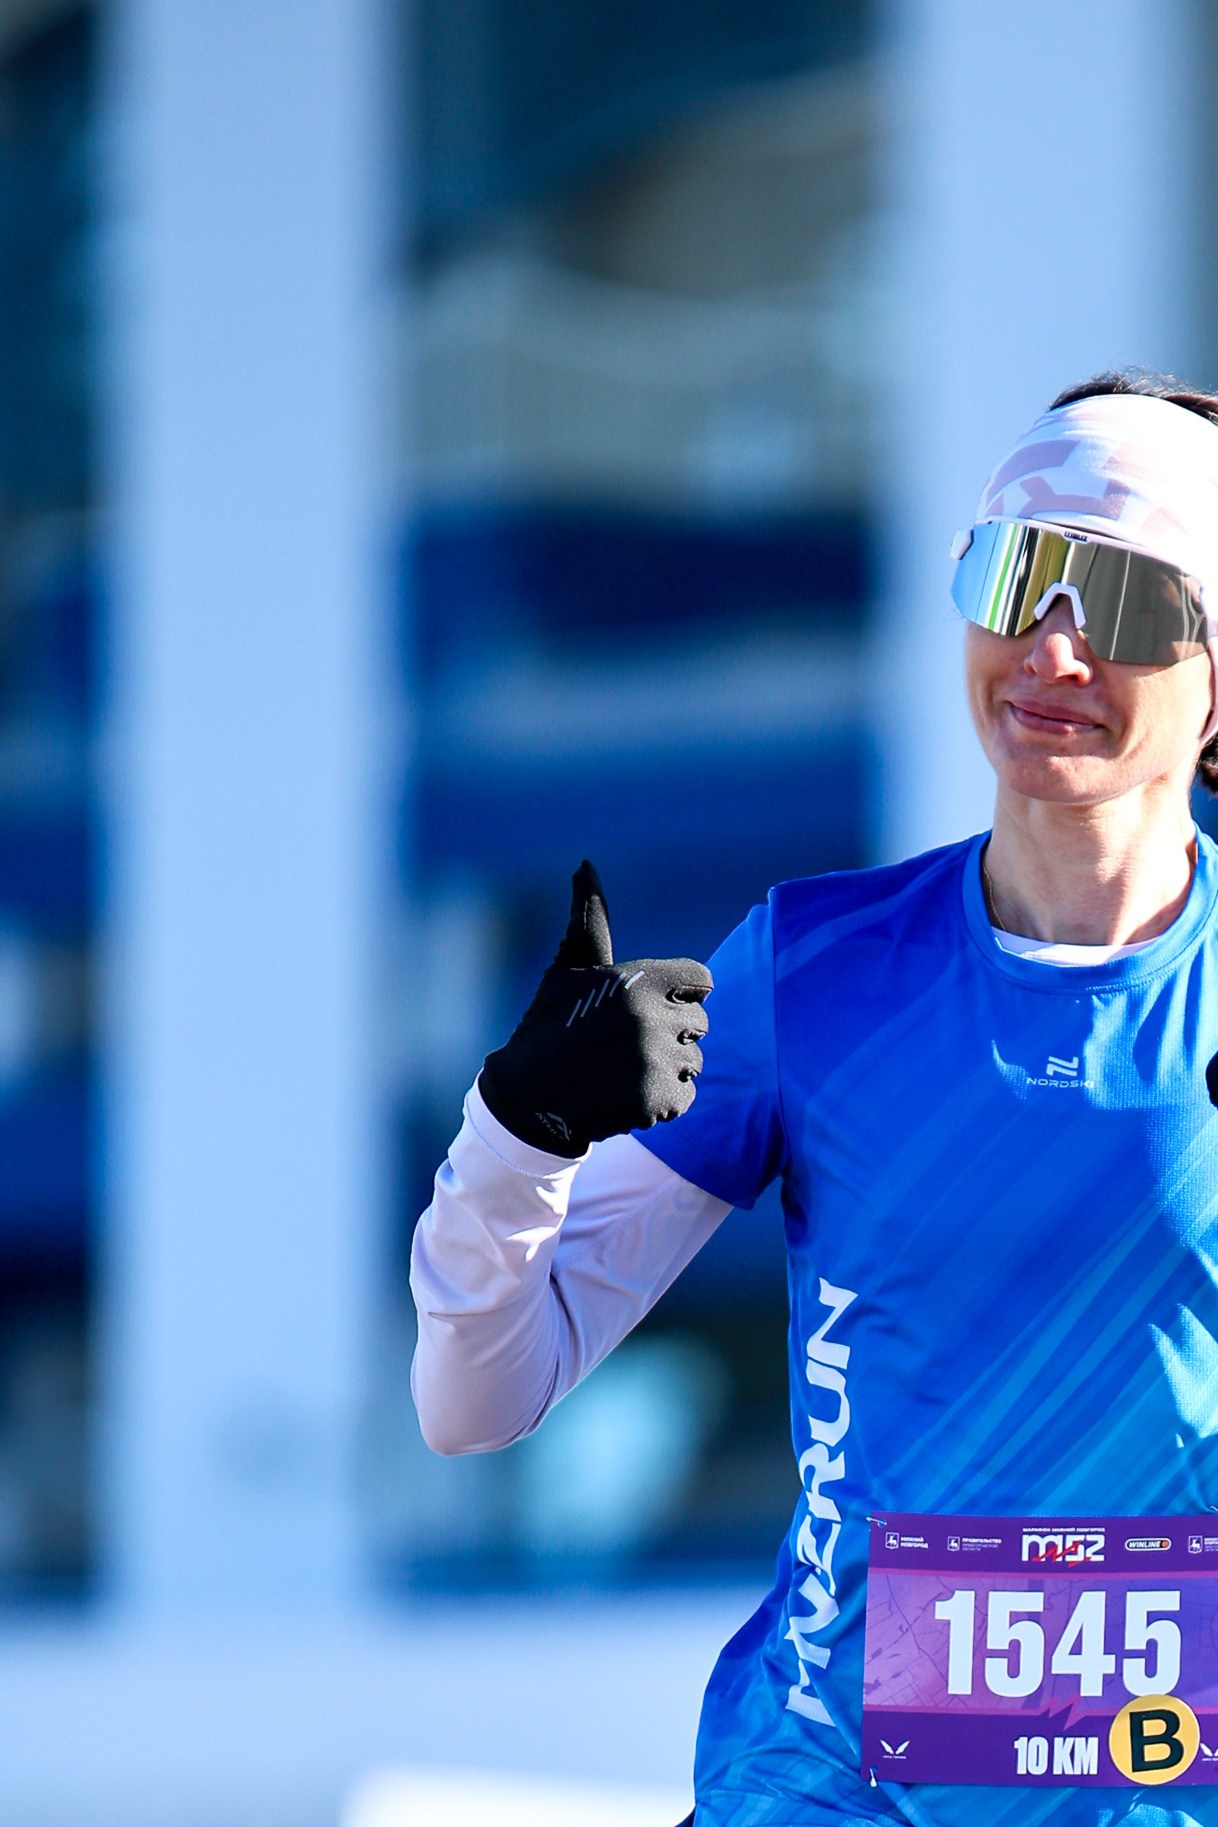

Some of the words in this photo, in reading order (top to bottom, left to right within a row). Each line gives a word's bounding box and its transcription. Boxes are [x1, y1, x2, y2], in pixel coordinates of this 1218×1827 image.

[1026, 1077, 1095, 1089] NORDSKI
[1129, 1540, 1161, 1549] WINLINE
[934, 1590, 1181, 1697] 1545
[1014, 1736, 1049, 1775] 10
[1053, 1736, 1098, 1775] KM
[1129, 1708, 1185, 1773] B
